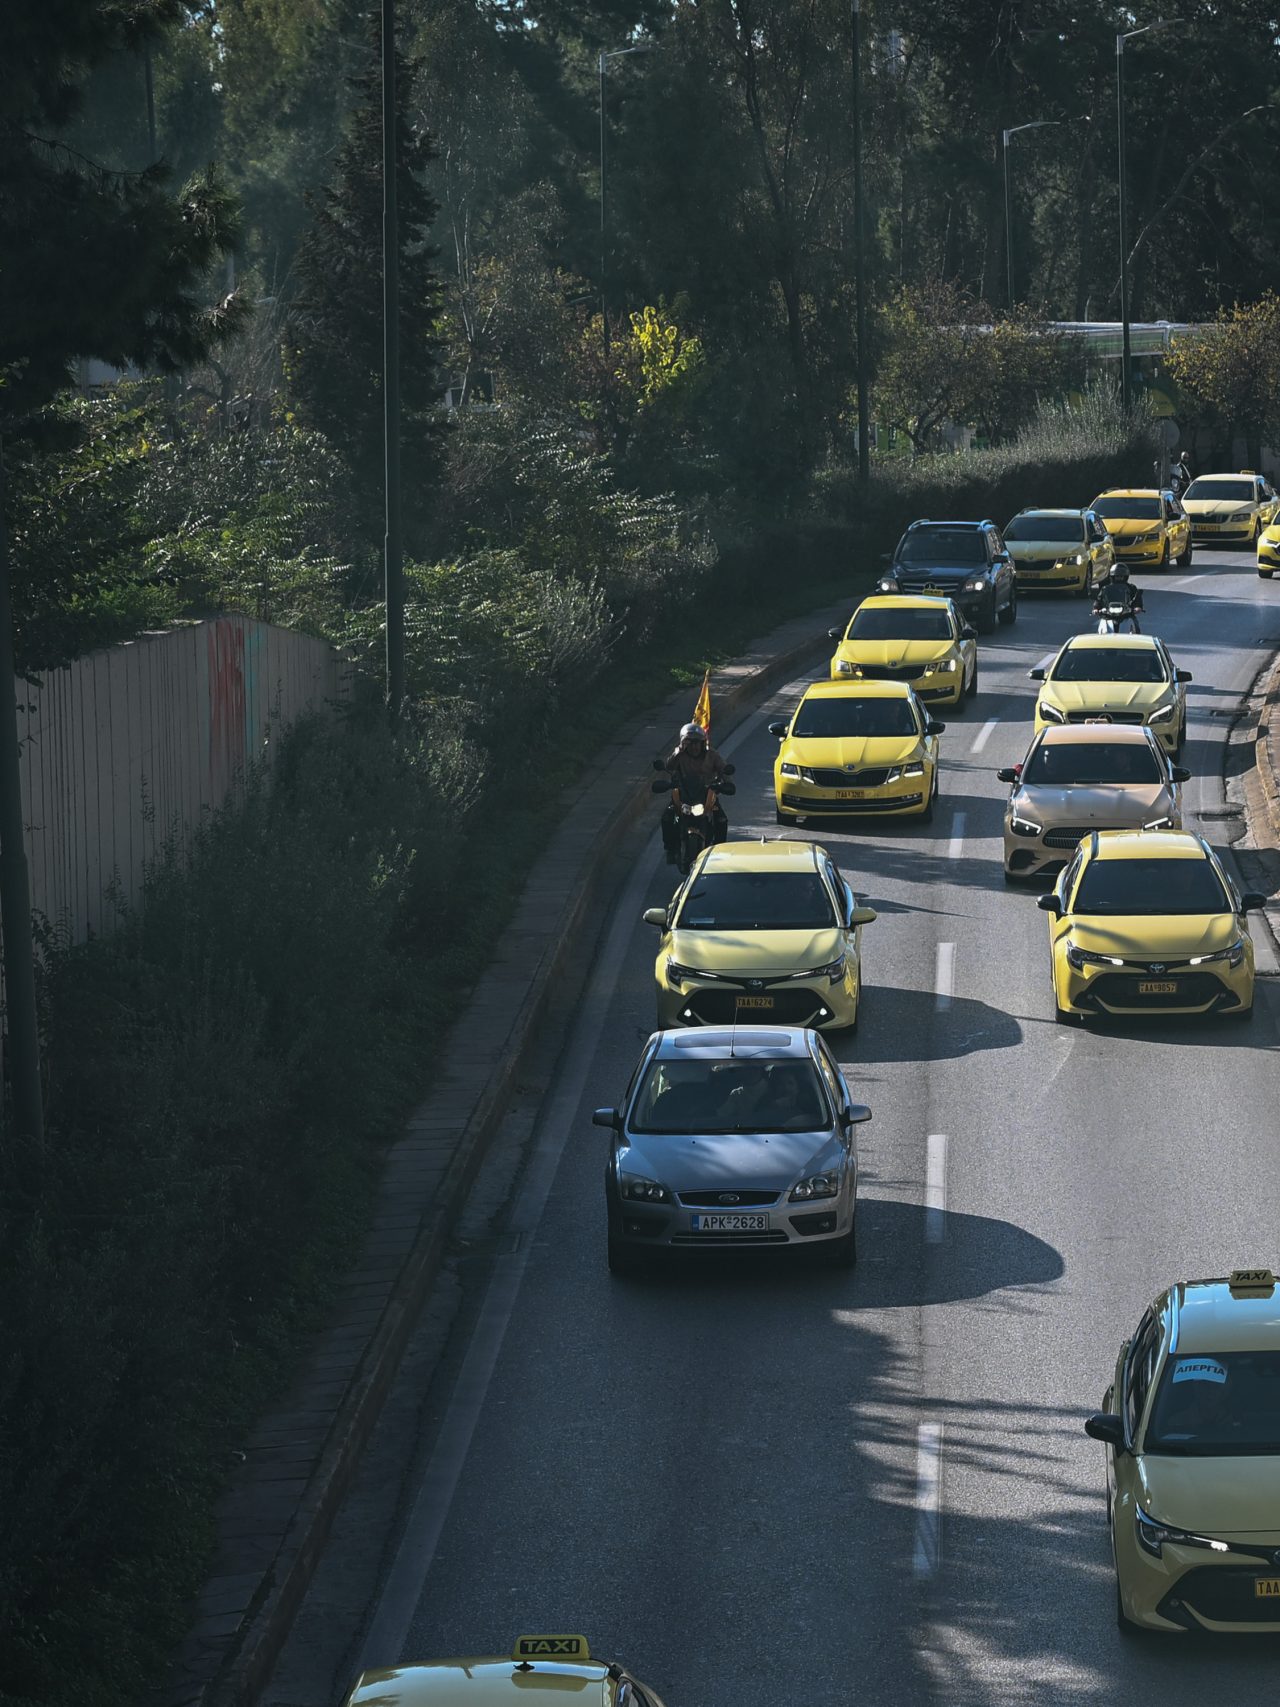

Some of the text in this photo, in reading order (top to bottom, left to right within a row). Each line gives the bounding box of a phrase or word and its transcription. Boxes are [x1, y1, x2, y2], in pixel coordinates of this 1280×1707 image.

[1235, 1272, 1267, 1281] TAXI
[1176, 1364, 1225, 1376] ΑΠΕΡΓΙΑ
[523, 1640, 577, 1653] TAXI
